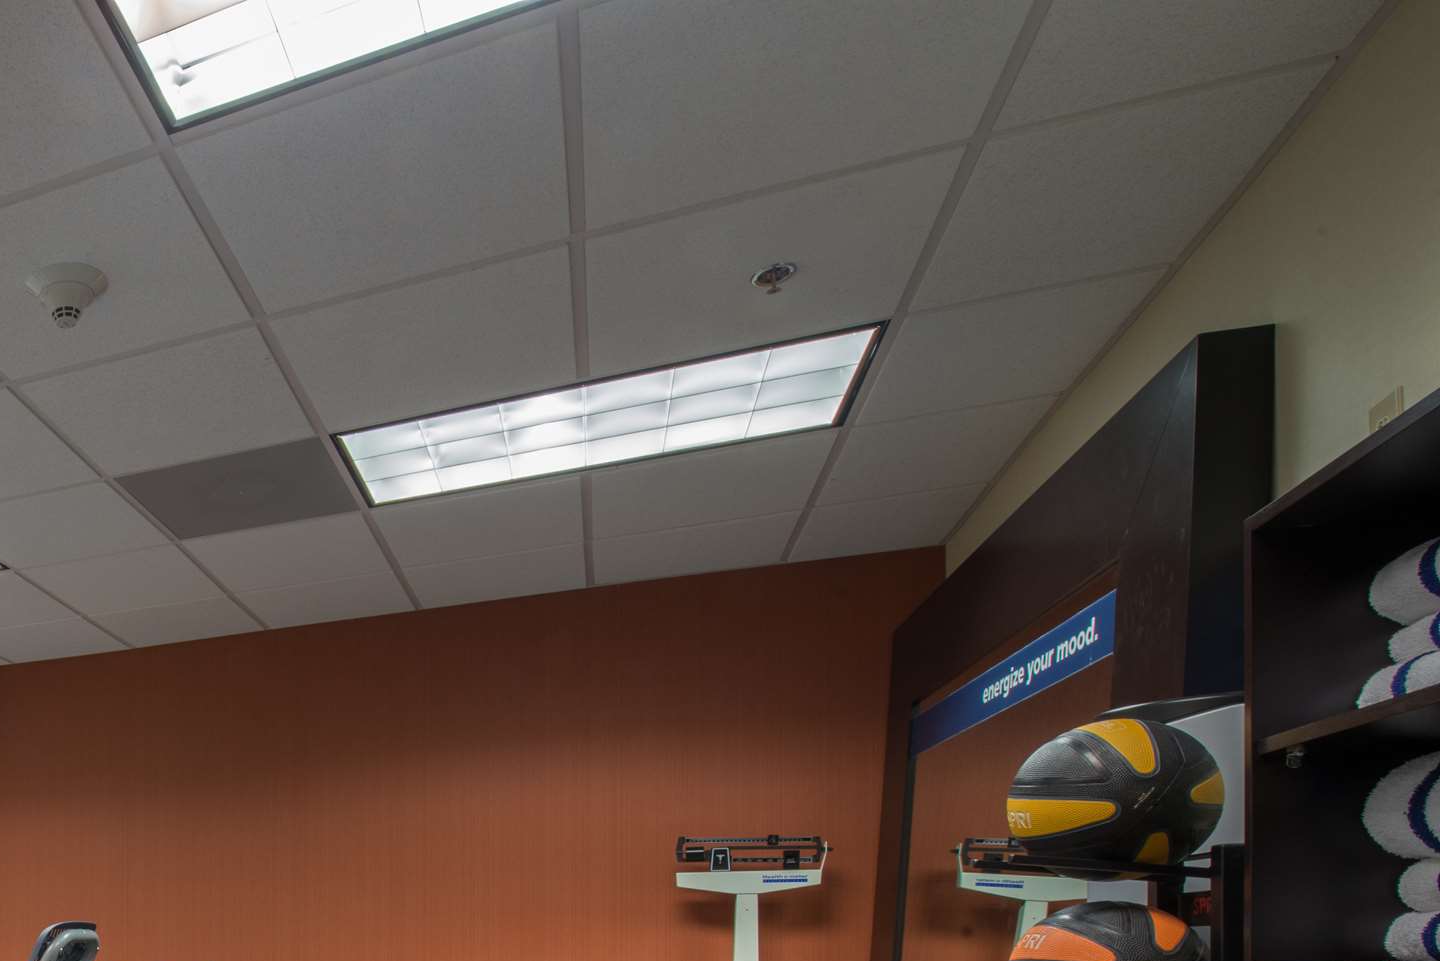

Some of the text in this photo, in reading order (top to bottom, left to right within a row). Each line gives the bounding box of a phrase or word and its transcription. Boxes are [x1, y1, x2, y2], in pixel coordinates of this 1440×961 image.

[982, 616, 1099, 704] energize your mood.
[1007, 811, 1032, 829] PRI
